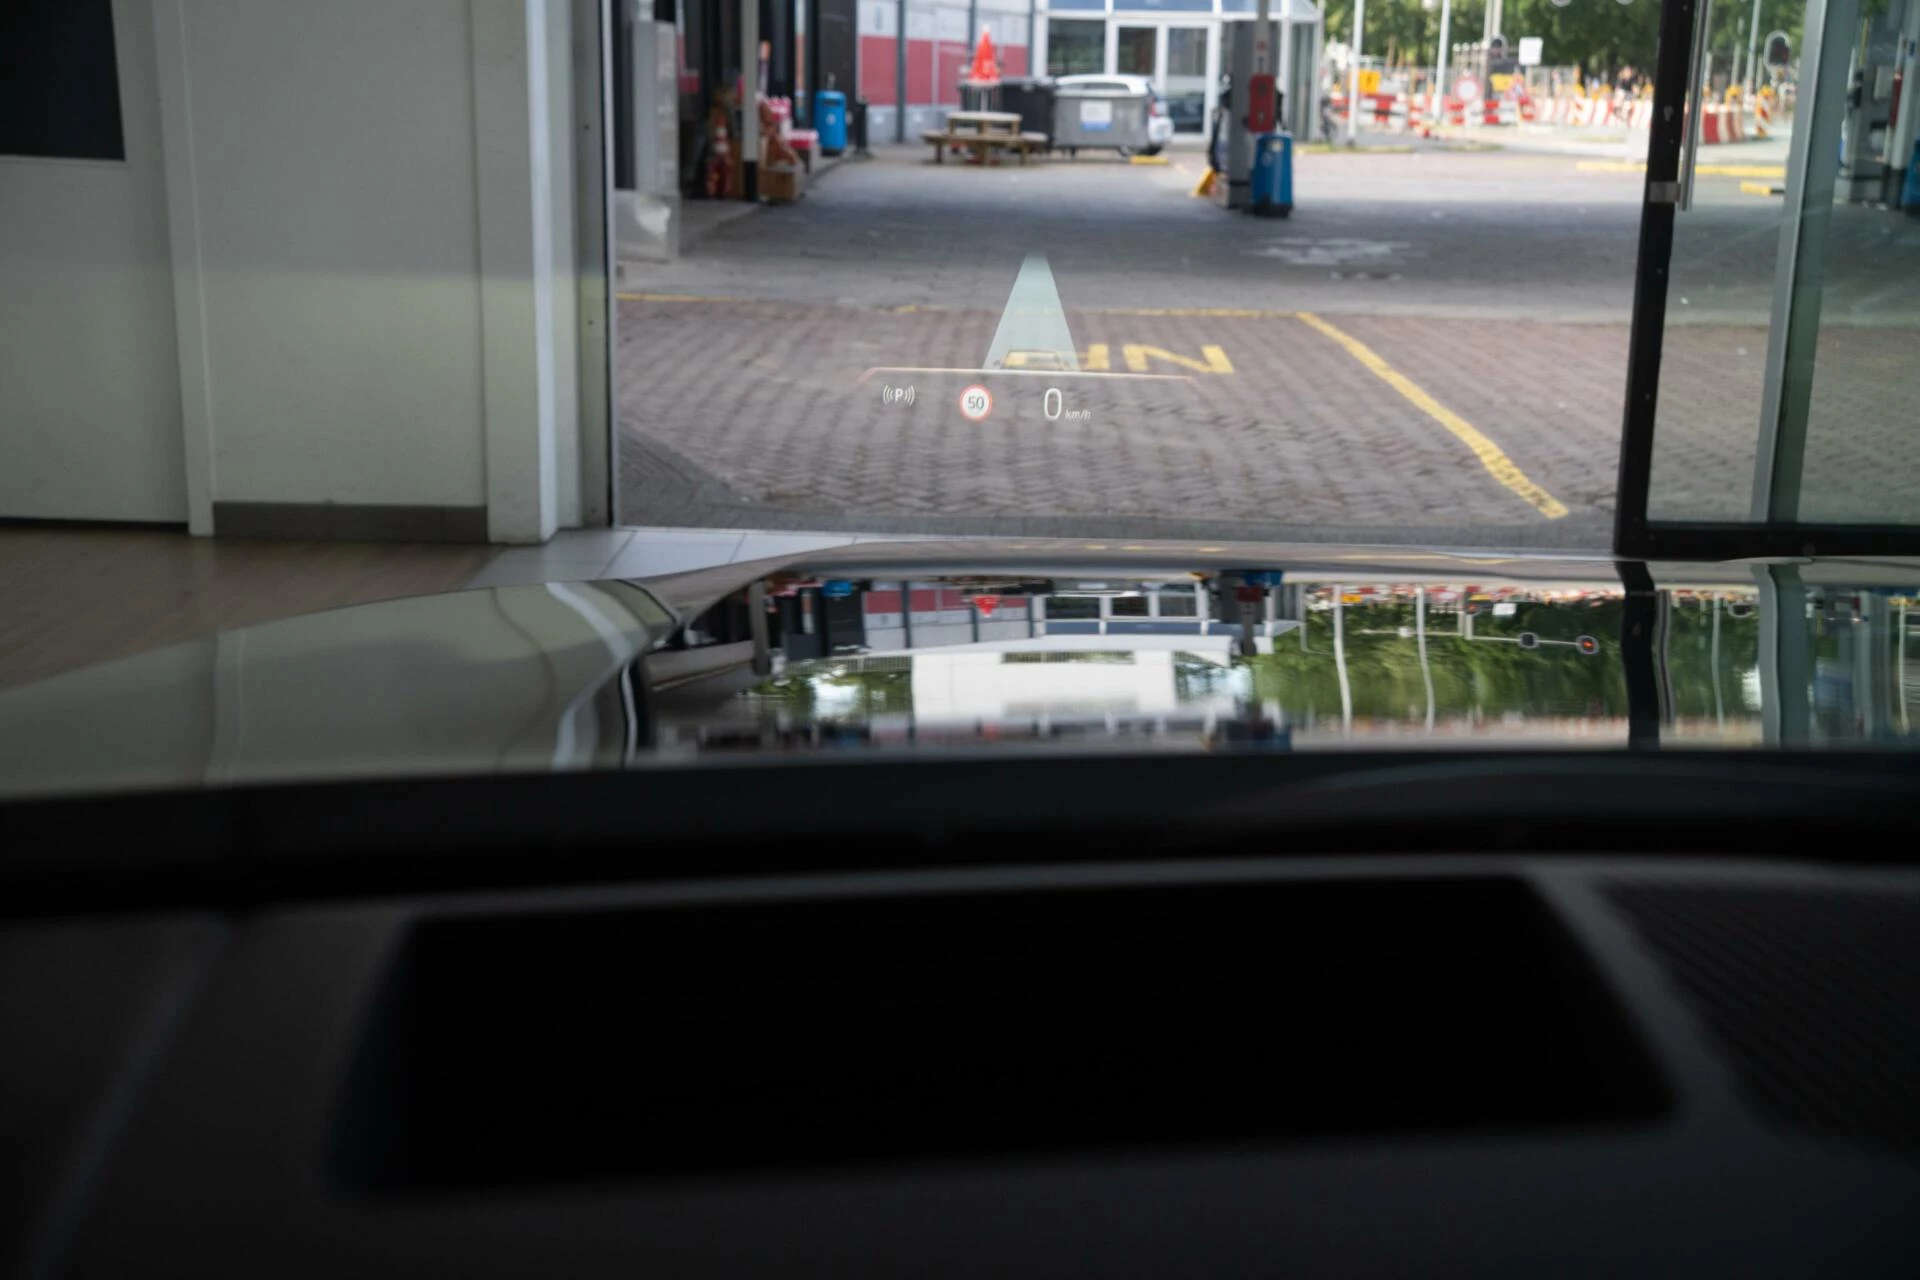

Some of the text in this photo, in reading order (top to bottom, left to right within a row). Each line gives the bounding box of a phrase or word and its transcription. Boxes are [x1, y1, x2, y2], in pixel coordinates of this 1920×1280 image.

[967, 395, 985, 410] 50
[1044, 387, 1092, 421] 0 km/h
